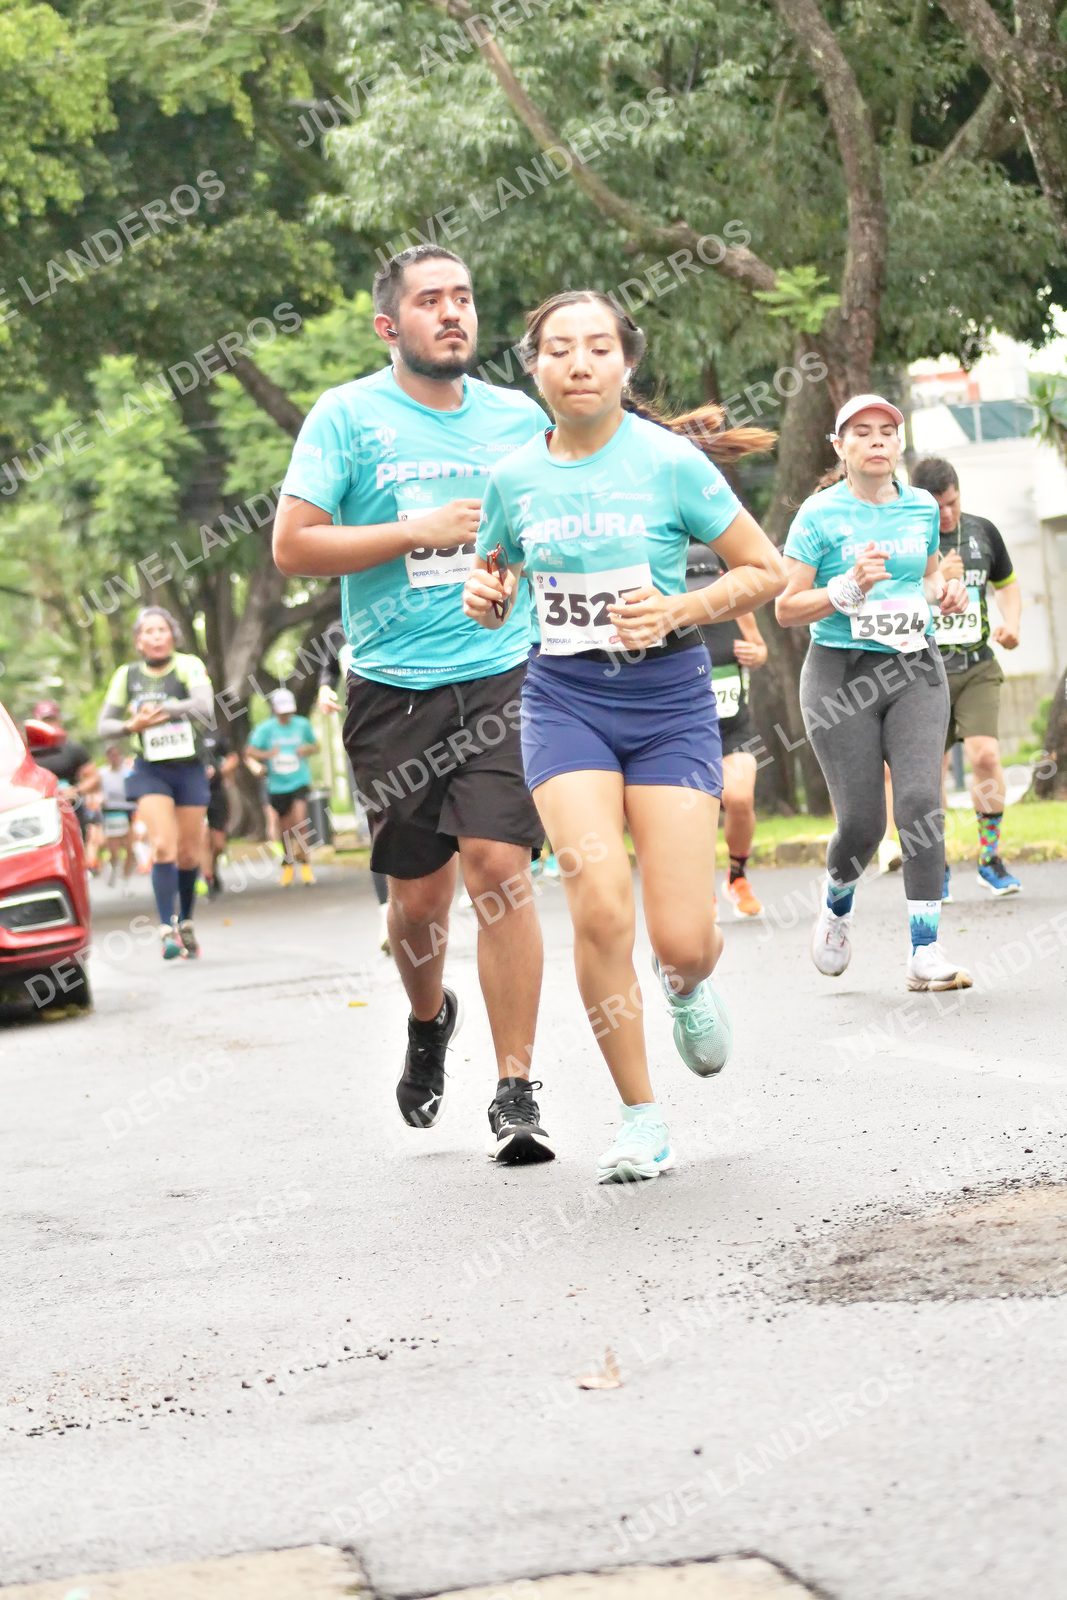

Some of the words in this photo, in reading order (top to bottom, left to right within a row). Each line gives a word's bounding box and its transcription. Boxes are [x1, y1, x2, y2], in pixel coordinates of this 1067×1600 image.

[857, 612, 925, 638] 3524
[931, 613, 978, 631] 3979
[717, 687, 740, 704] 76
